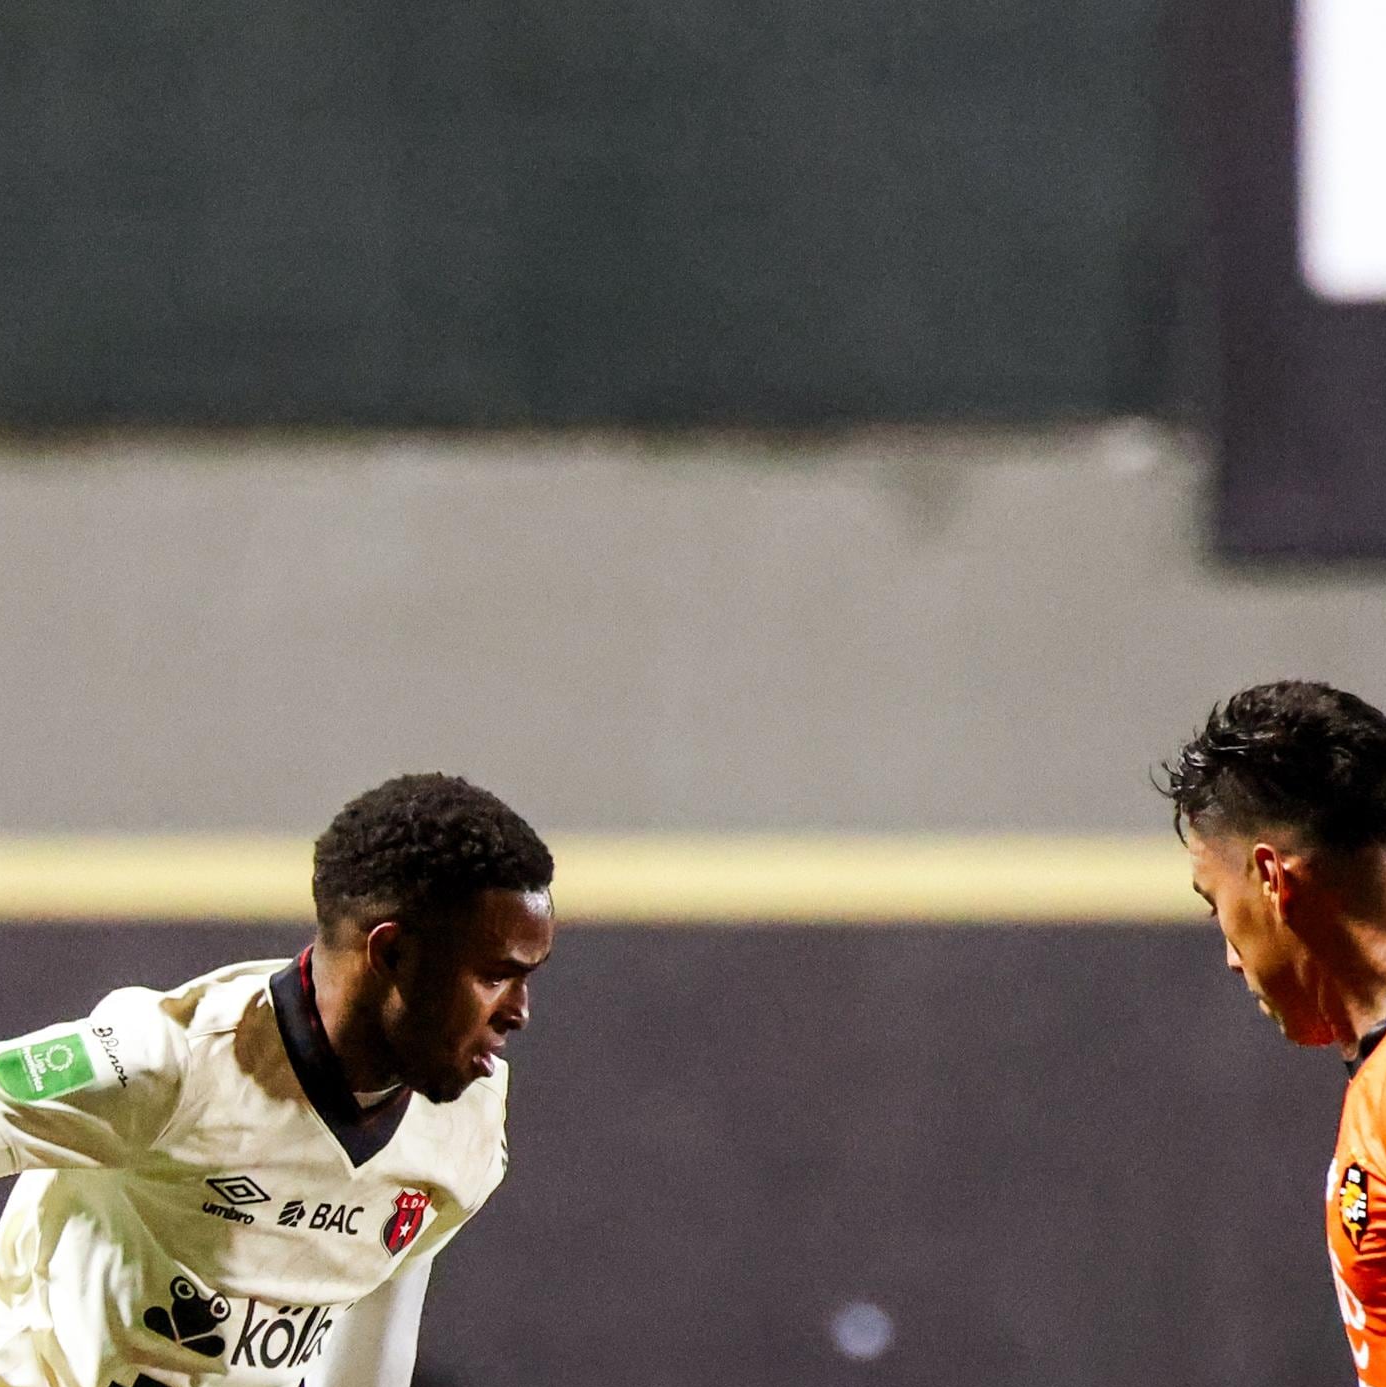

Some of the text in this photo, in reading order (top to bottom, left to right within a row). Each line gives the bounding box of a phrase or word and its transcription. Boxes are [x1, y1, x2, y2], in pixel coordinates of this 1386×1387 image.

[201, 1200, 255, 1225] umbro
[401, 1198, 425, 1209] LDA
[308, 1202, 365, 1235] BAC
